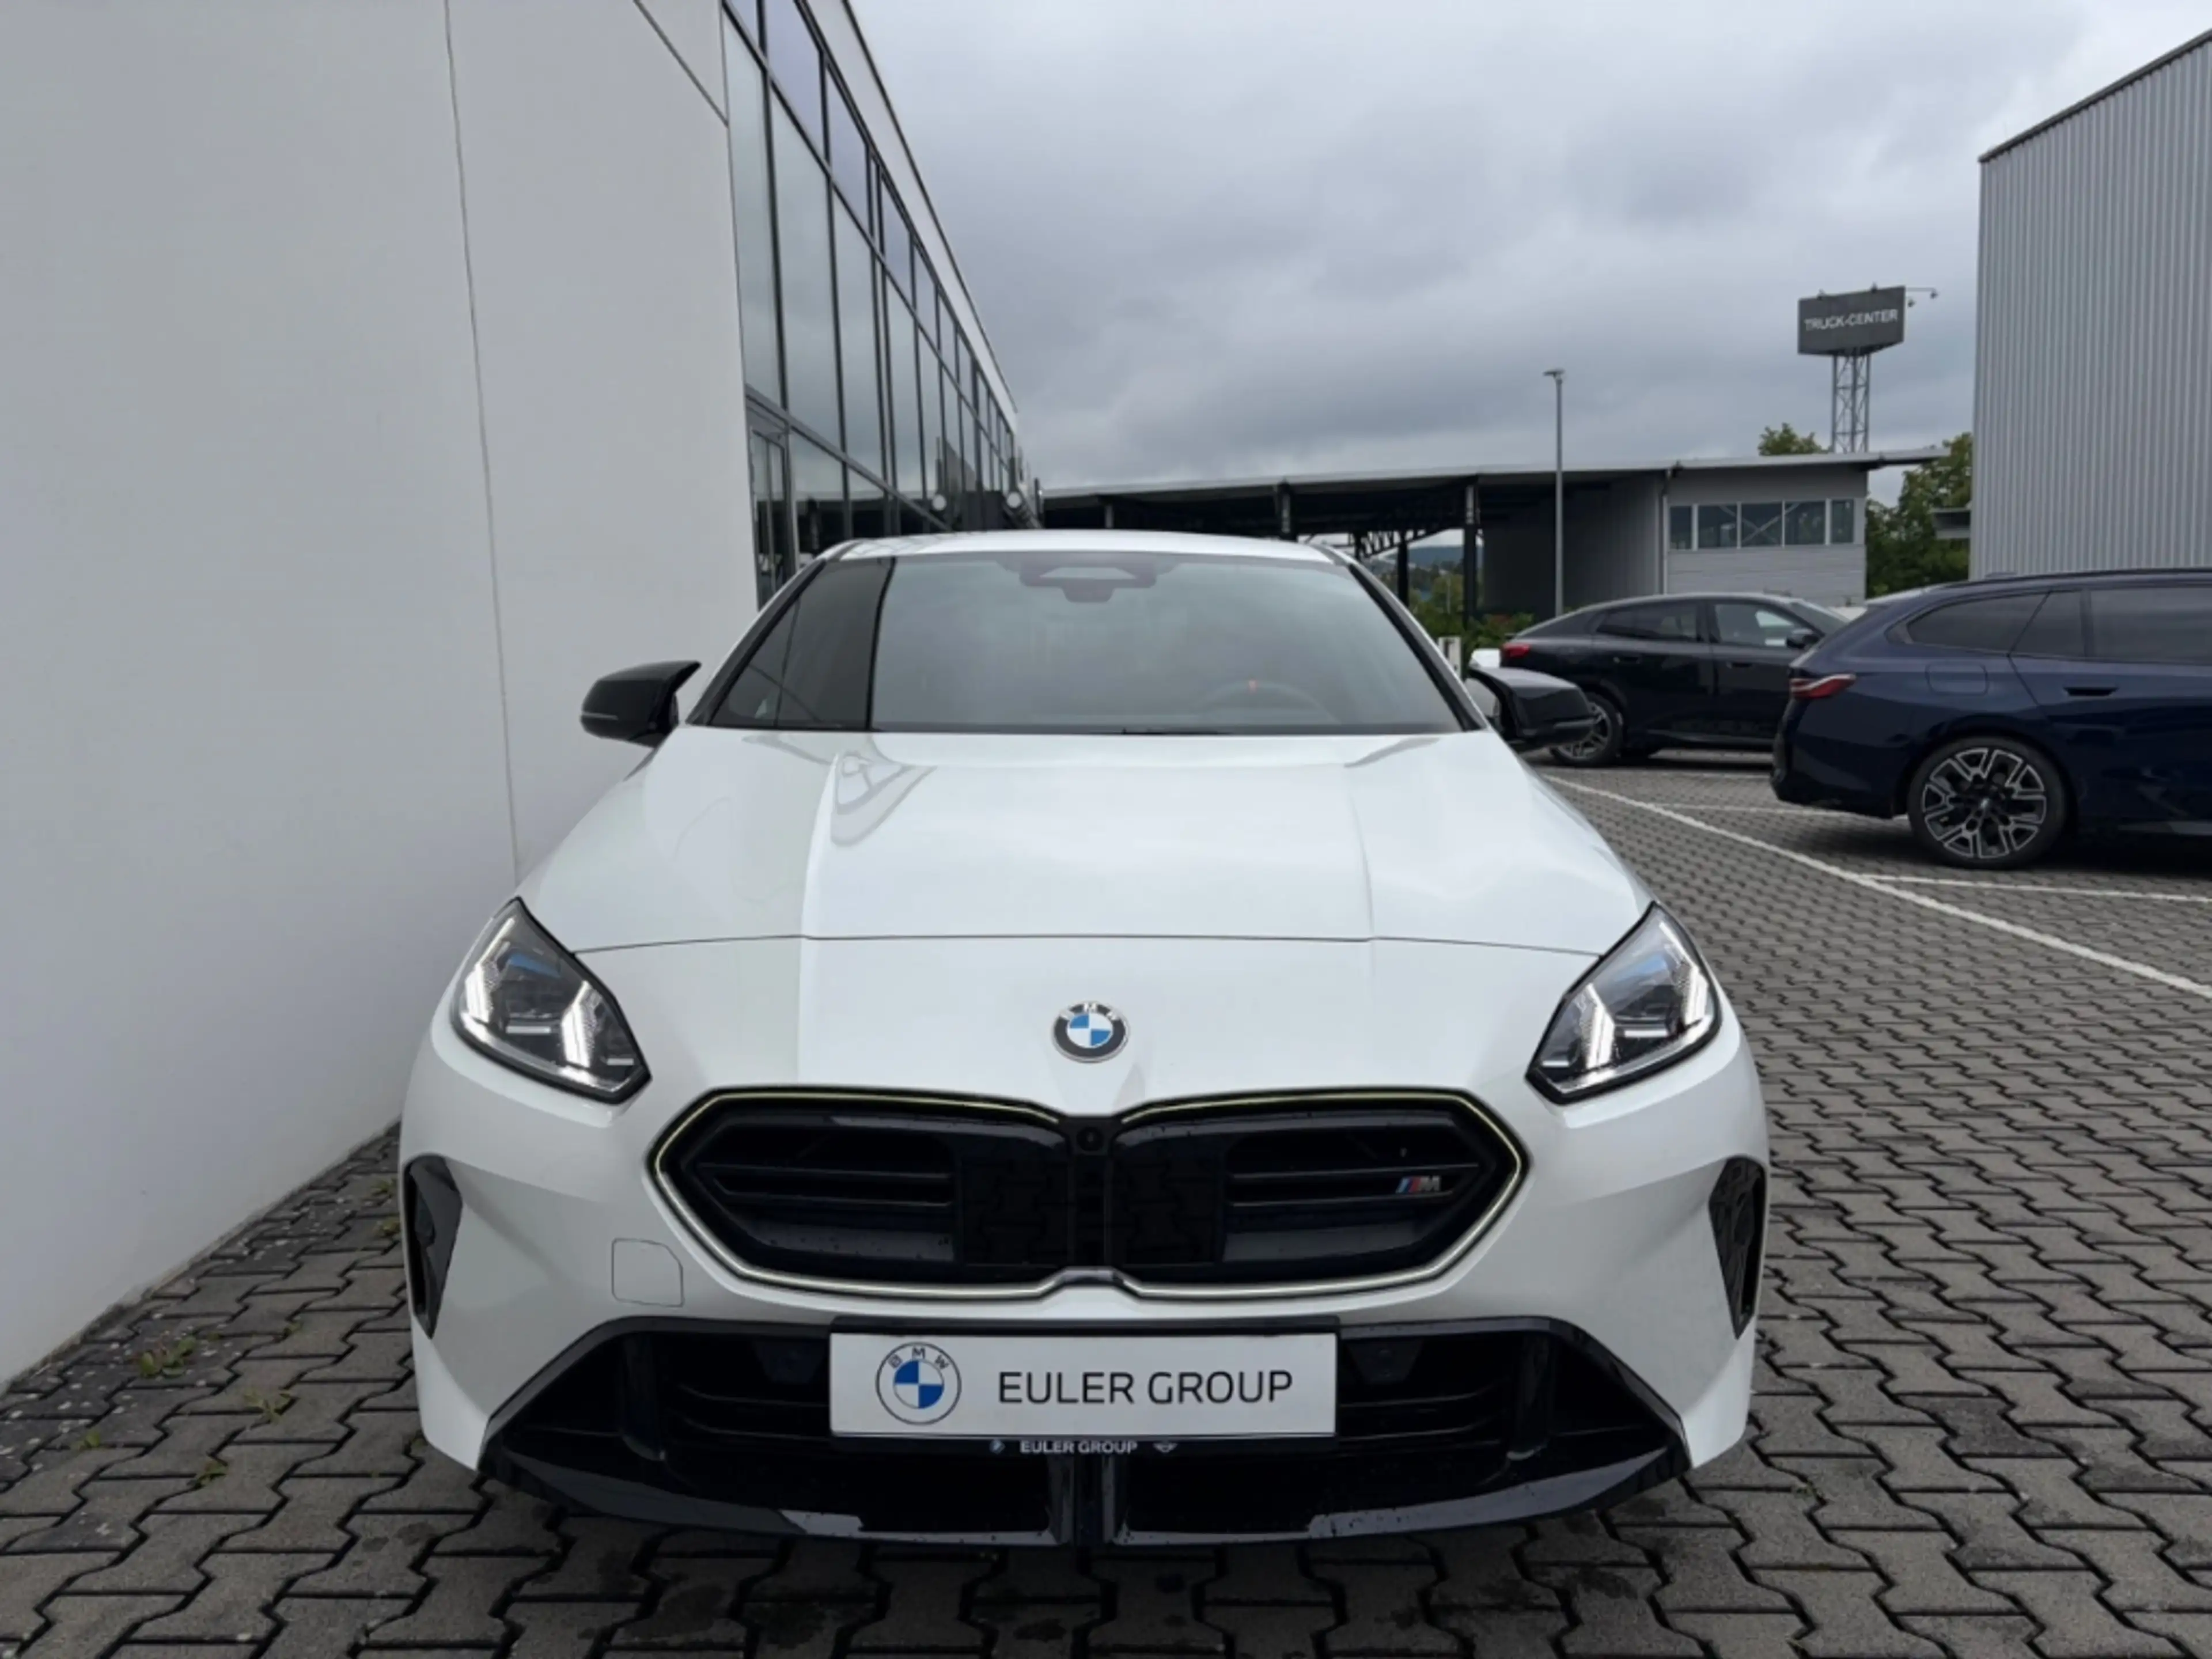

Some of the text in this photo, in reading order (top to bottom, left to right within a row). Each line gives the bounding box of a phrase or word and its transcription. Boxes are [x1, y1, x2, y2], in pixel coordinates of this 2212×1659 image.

[1804, 309, 1897, 331] TRUCK-CENTER
[888, 1347, 949, 1369] BMW
[999, 1370, 1293, 1404] EULER GROUP
[1020, 1440, 1138, 1454] EULER GROUP
